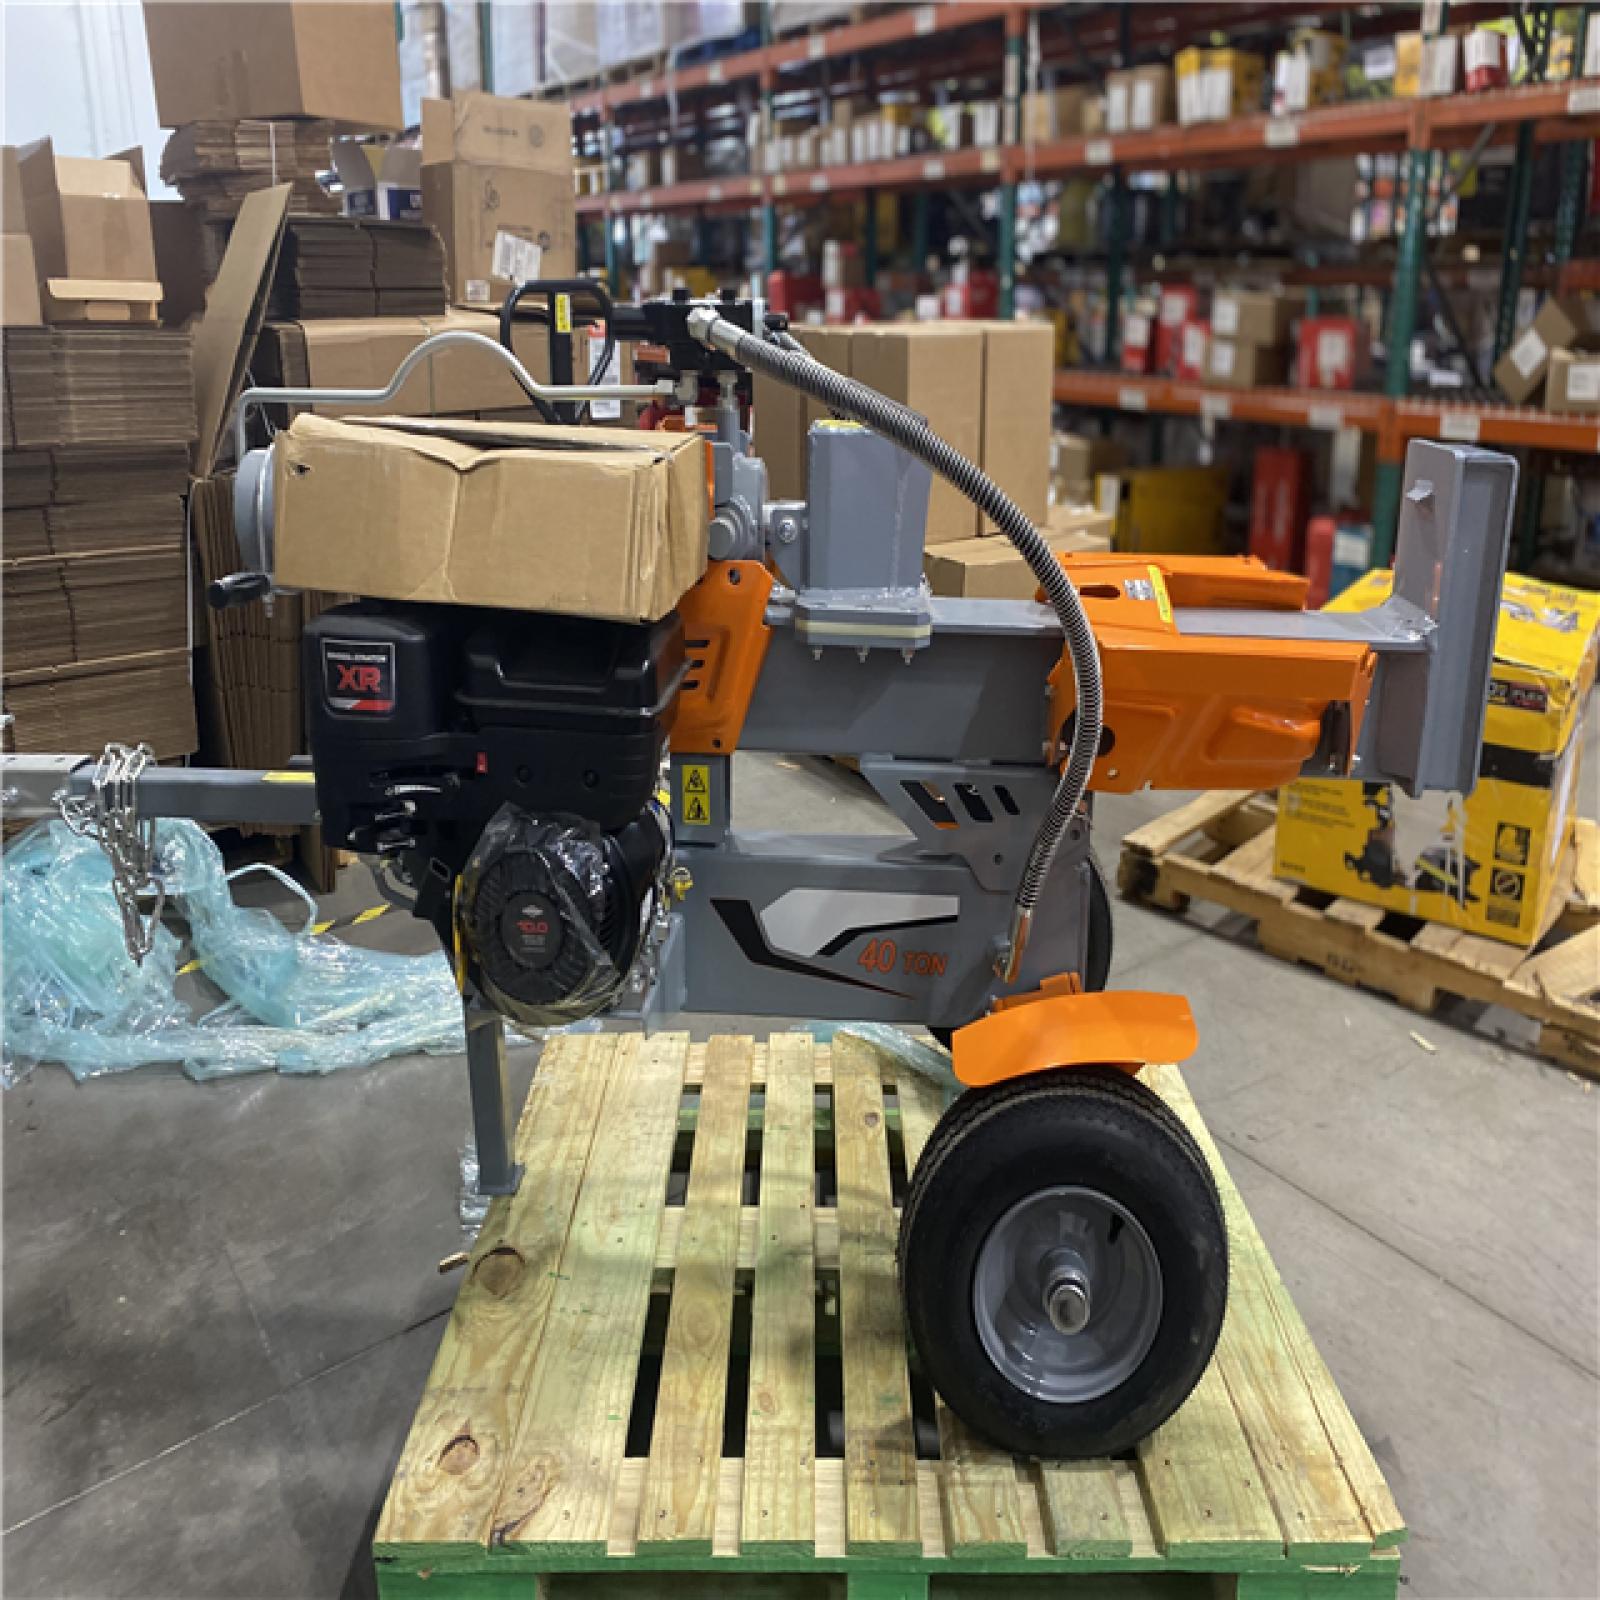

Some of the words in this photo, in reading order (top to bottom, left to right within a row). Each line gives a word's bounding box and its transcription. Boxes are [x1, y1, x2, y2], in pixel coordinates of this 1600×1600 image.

[337, 665, 381, 693] XR
[858, 938, 896, 973] 40
[903, 951, 949, 976] TON
